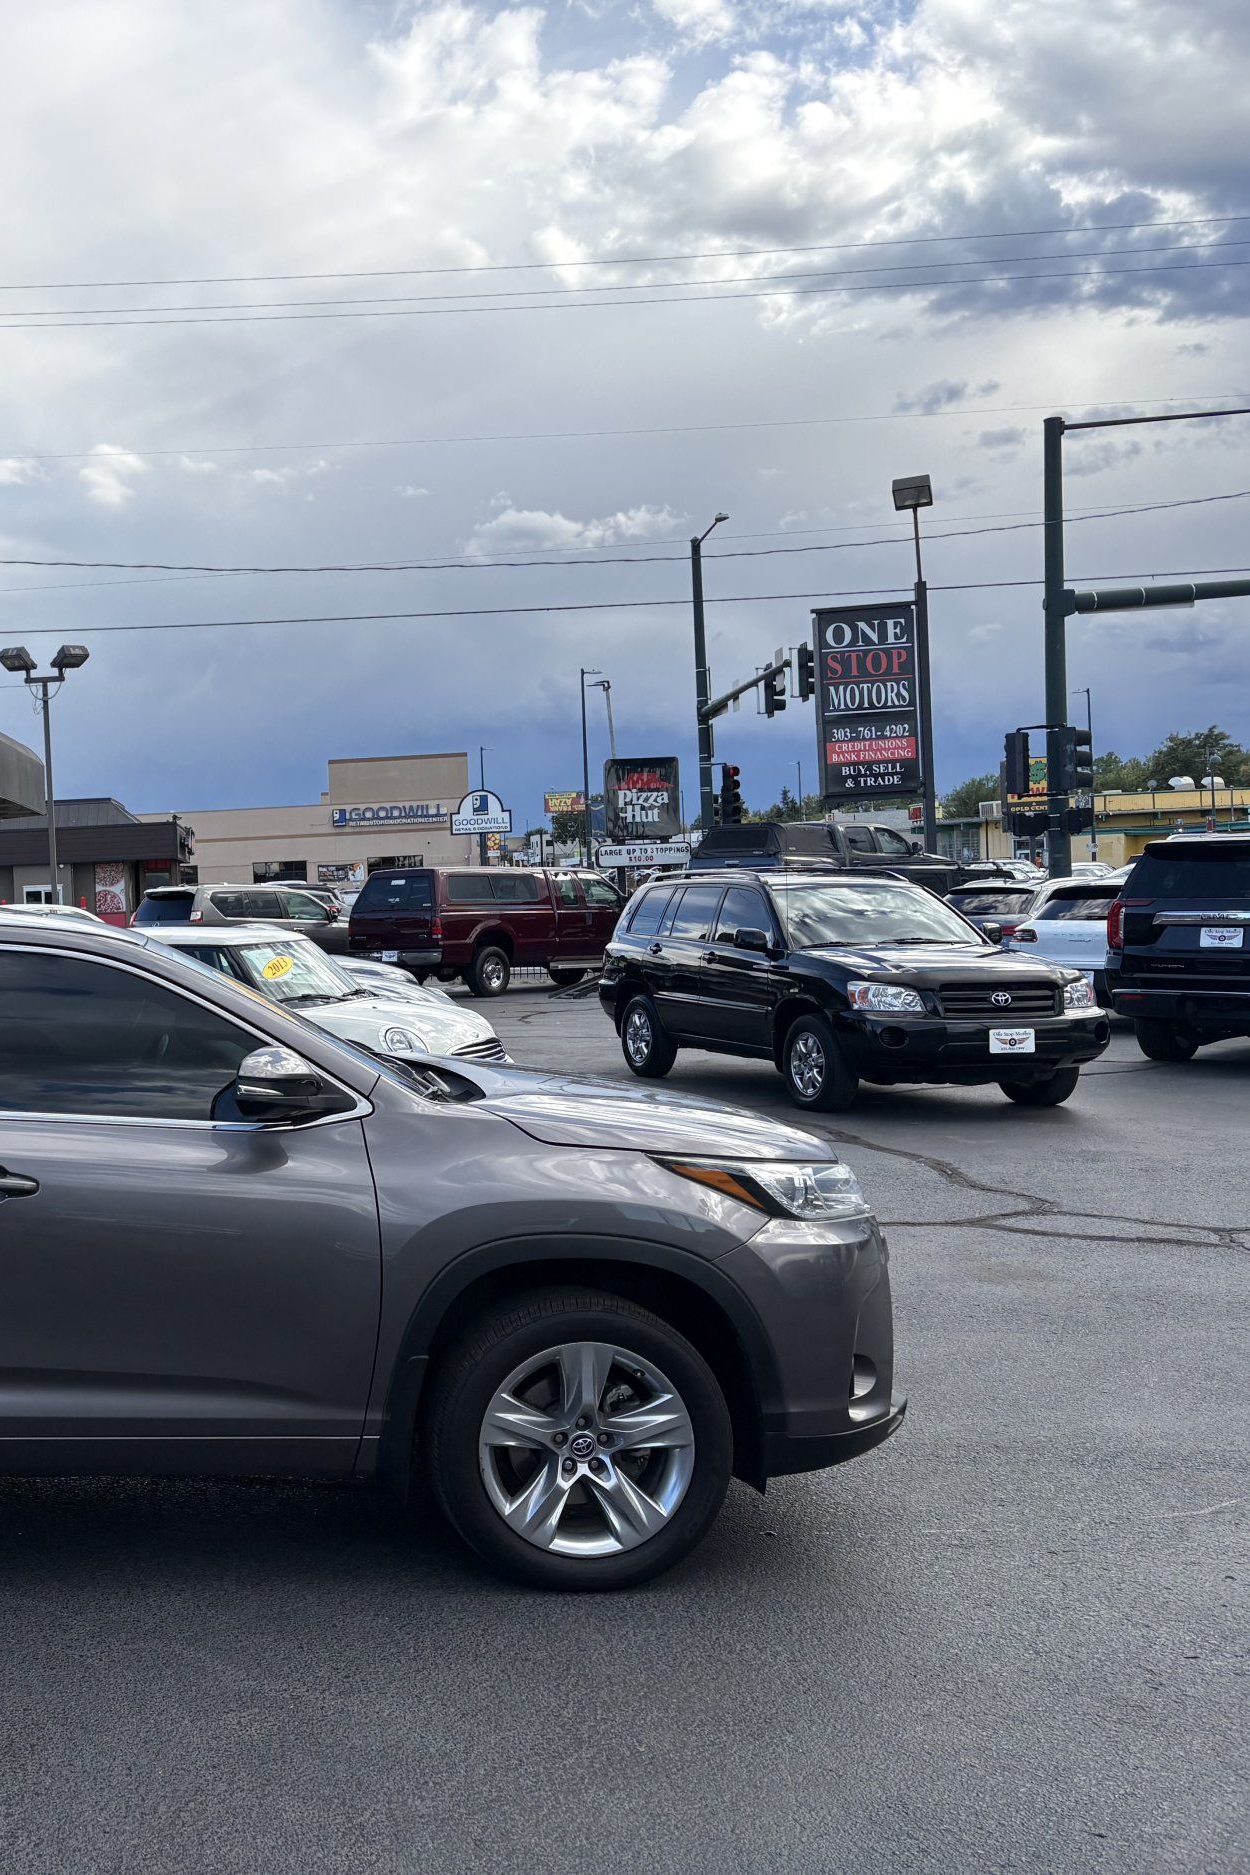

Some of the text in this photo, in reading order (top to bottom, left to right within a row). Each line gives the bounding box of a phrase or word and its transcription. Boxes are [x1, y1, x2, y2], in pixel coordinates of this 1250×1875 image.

[825, 618, 908, 648] ONE
[827, 649, 907, 678] STOP
[828, 680, 910, 710] MOTORS
[835, 738, 908, 752] CREDIT UNIONS
[832, 748, 912, 762] BANK FINANCING
[841, 762, 905, 776] BUY, SELL
[845, 774, 902, 788] & TRADE
[618, 788, 669, 807] Pizza
[349, 803, 448, 820] GOODWILL
[619, 804, 660, 823] Hut
[454, 817, 508, 826] GOODWILL
[600, 848, 623, 857] LARGE
[626, 848, 637, 856] UP
[639, 847, 648, 855] TO
[655, 845, 690, 855] TOPPINGS
[267, 957, 288, 976] 2013
